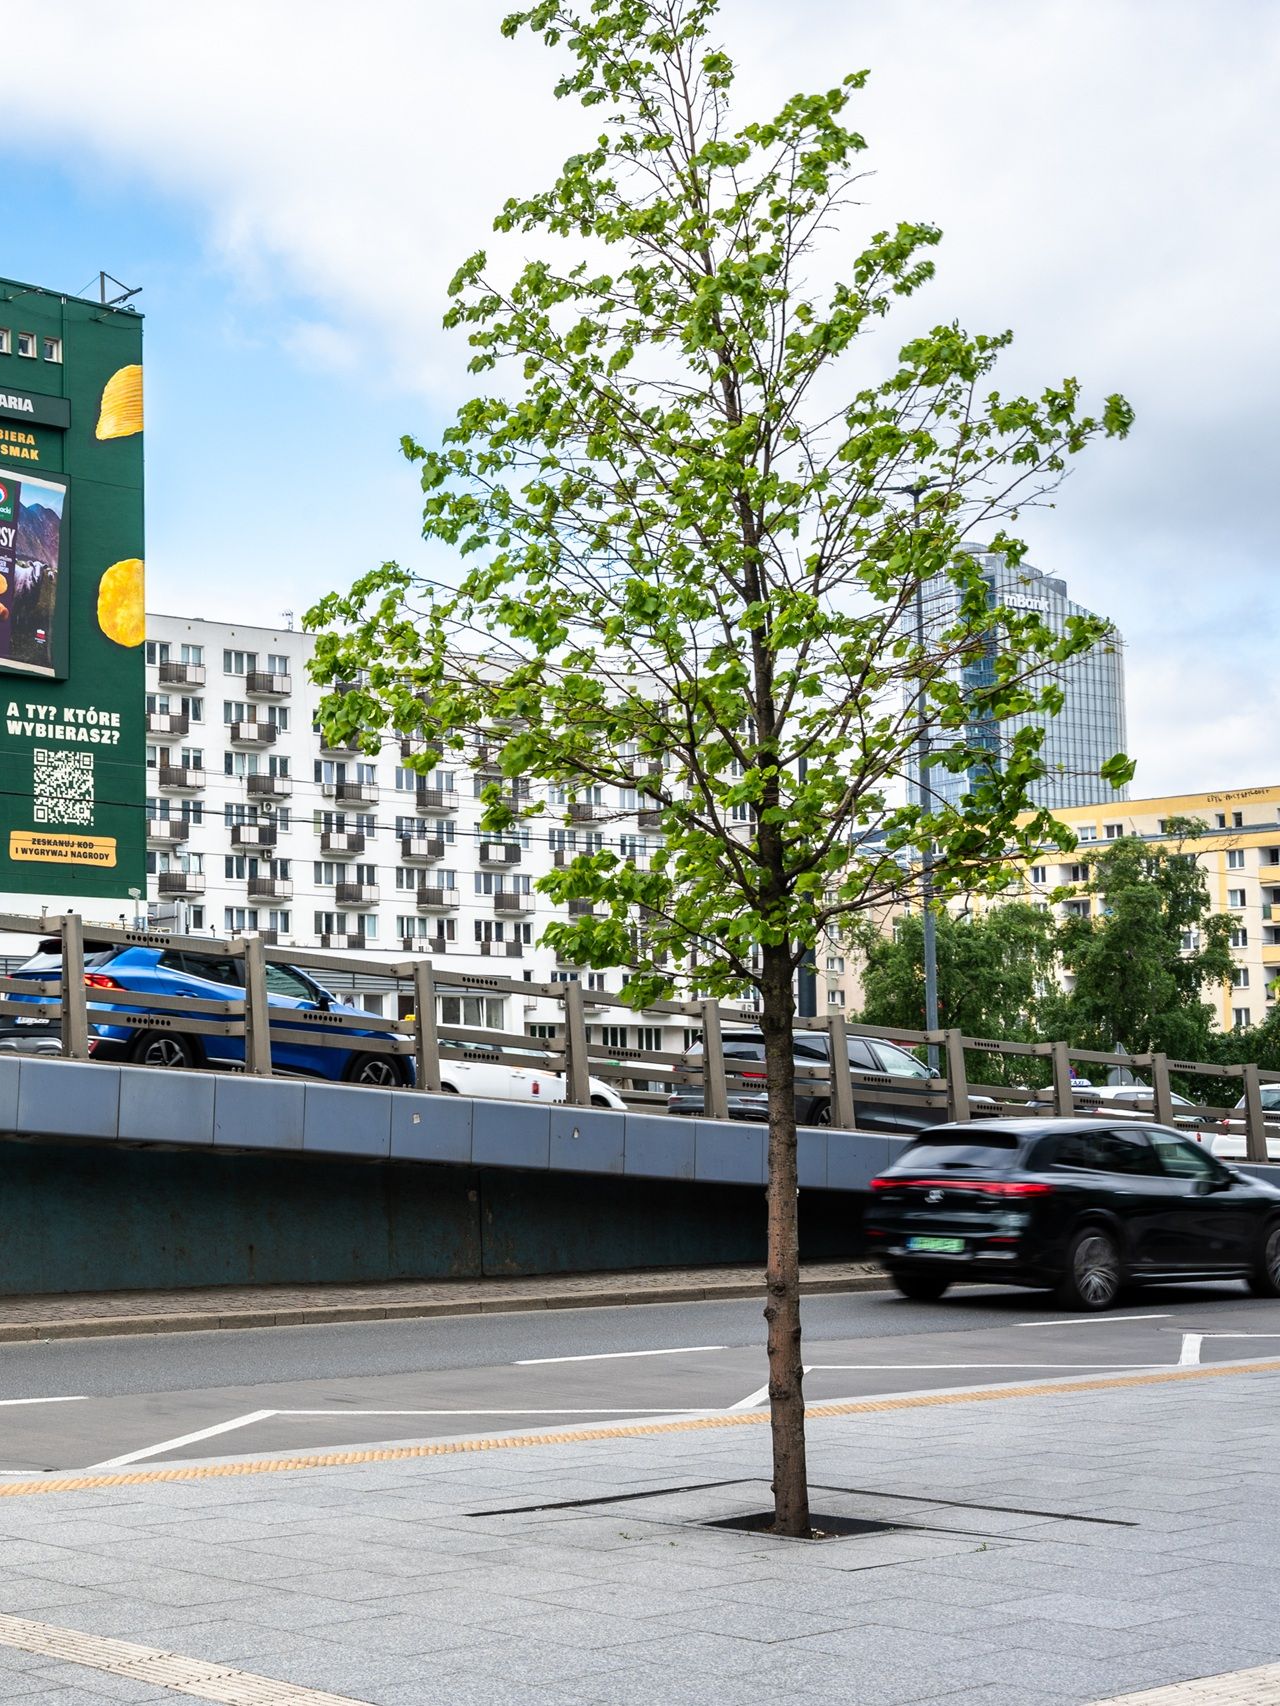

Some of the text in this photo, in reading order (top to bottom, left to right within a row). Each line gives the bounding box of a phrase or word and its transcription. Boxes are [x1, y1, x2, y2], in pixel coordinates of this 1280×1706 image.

[0, 444, 39, 461] SMAK
[1004, 593, 1050, 612] mBank
[6, 702, 120, 727] A TY? KTÓRE
[6, 720, 120, 745] WYBIERASZ?
[32, 838, 94, 849] ZESKANUJ KOD
[21, 848, 68, 857] WYGRYWAJ
[71, 851, 110, 860] NAGRODY
